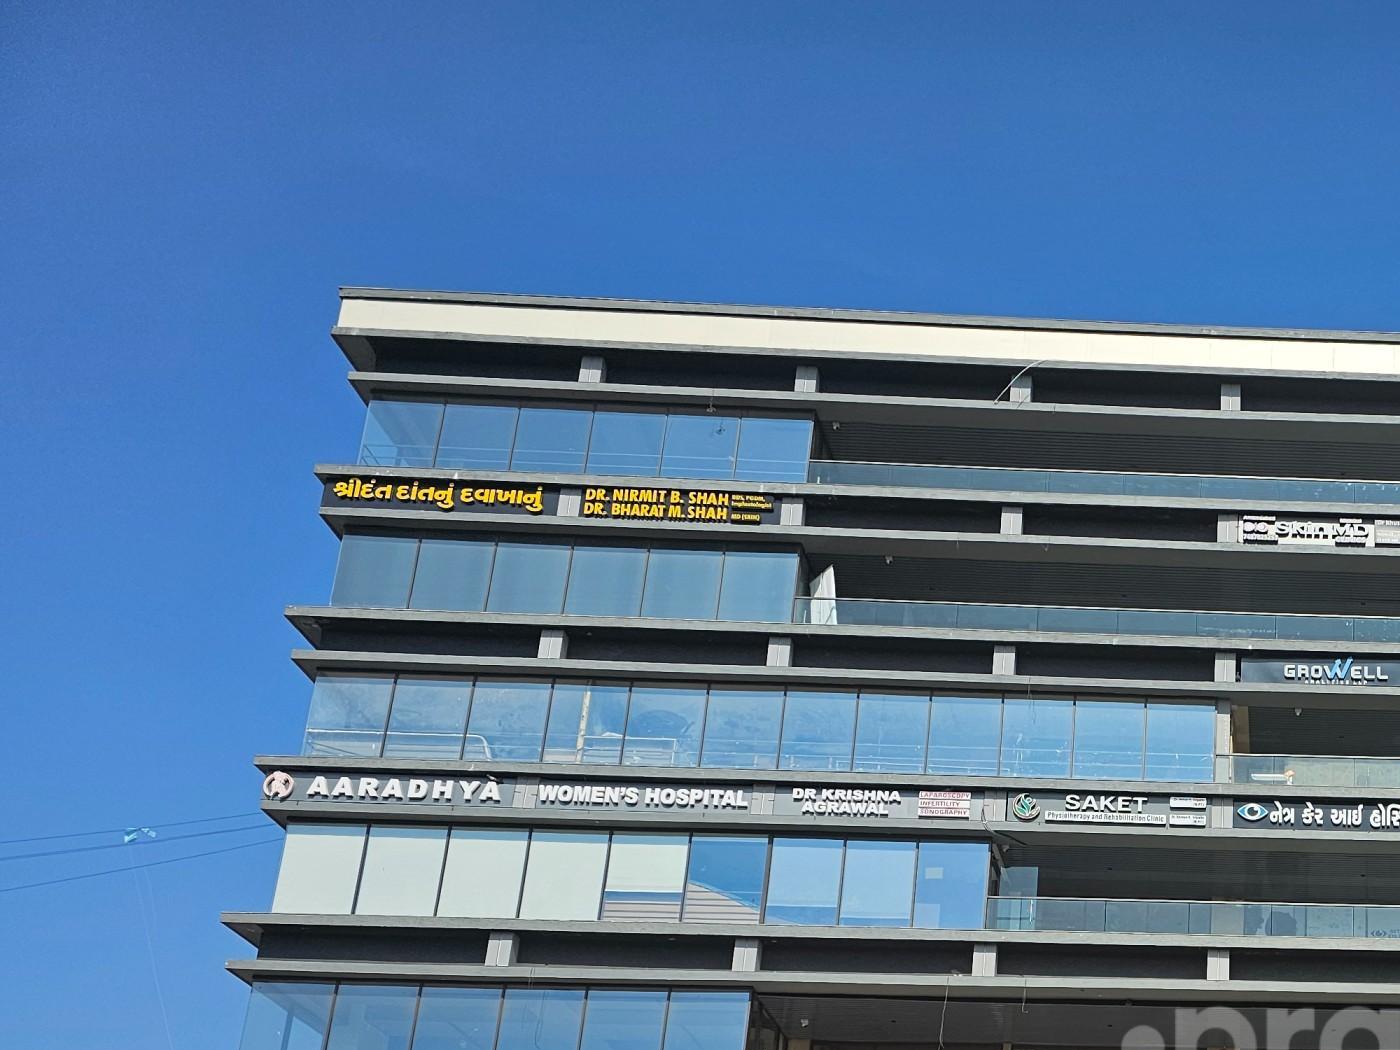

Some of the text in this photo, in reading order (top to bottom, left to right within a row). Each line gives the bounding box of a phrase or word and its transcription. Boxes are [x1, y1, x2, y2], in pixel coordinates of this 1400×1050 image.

[585, 488, 729, 506] DR. NIRMIT B. SHAH
[583, 502, 728, 520] DR. BHARAT M. SHAH
[1284, 657, 1389, 680] GROWELL
[306, 776, 501, 802] AARADHYA
[539, 784, 749, 808] WOMEN'S HOSPITAL
[792, 787, 901, 803] DR KRISHNA
[801, 801, 889, 815] AGRAWAL
[1064, 794, 1148, 813] SAKET
[1146, 814, 1164, 822] Clinic
[1301, 801, 1324, 826] કેર
